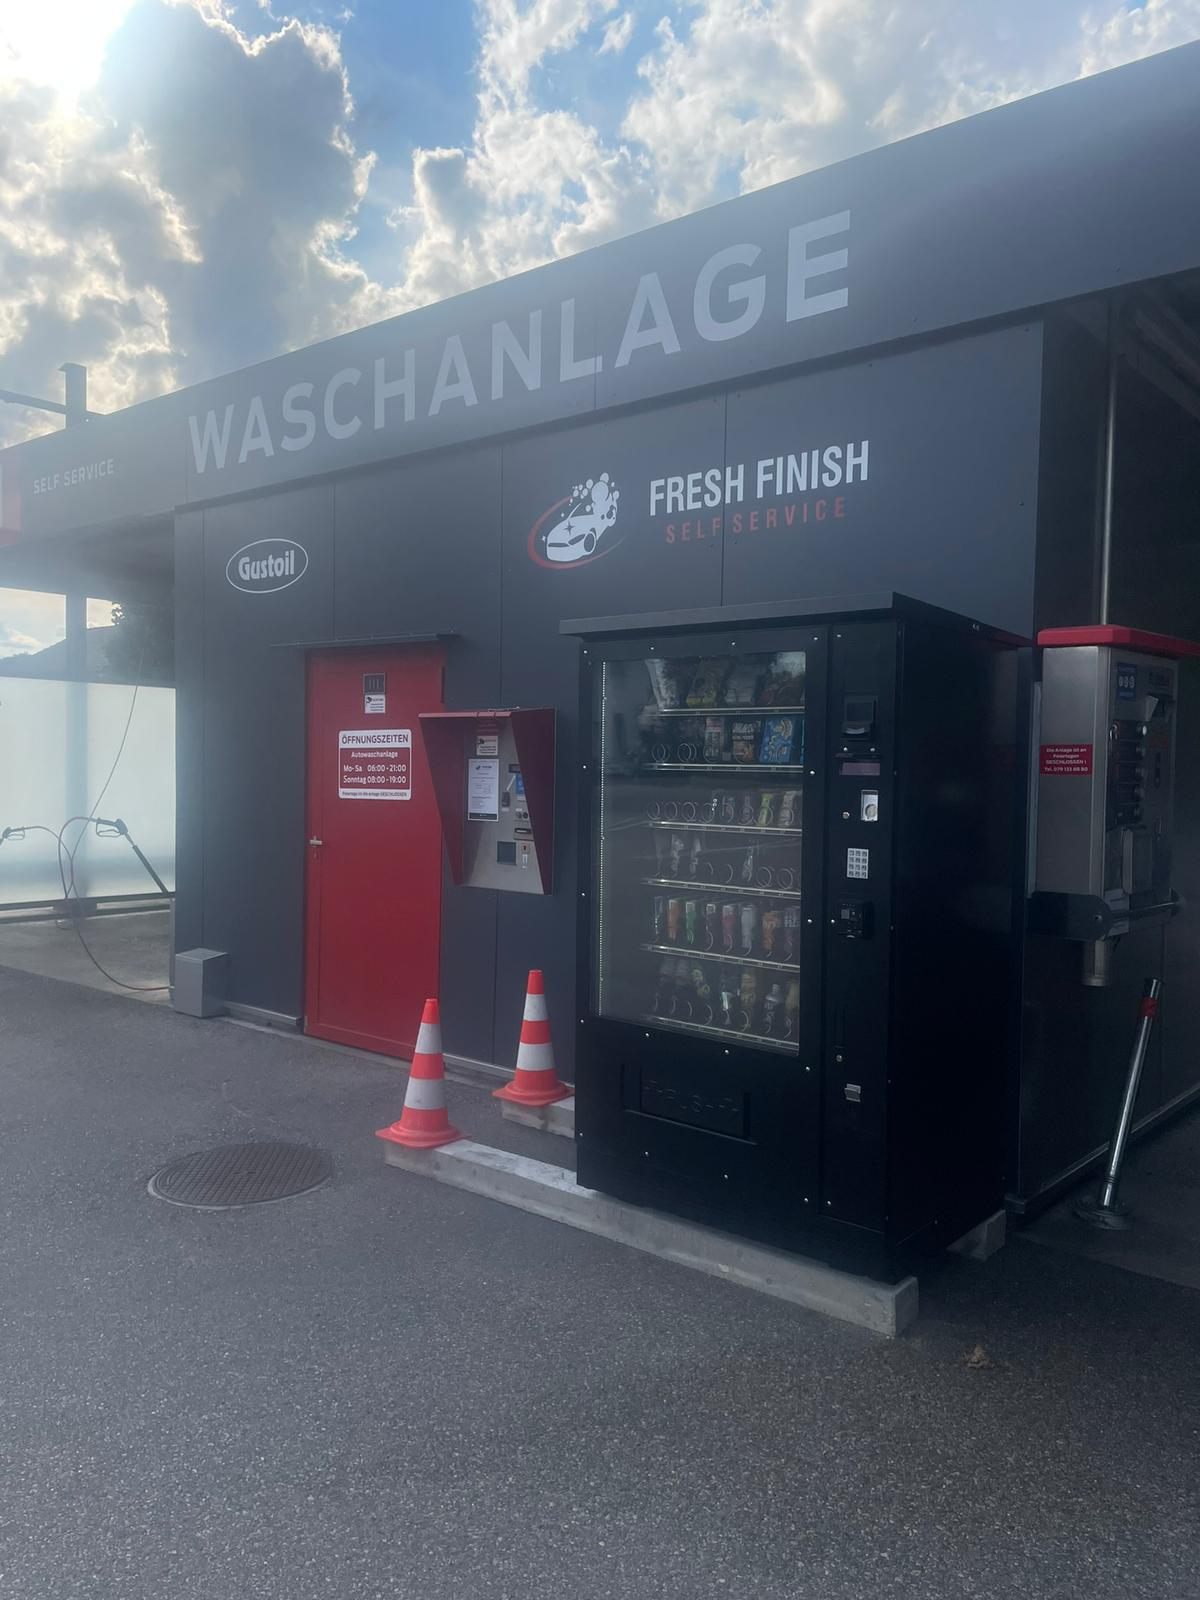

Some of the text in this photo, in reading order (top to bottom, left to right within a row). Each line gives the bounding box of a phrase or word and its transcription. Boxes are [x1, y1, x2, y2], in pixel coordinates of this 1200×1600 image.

[188, 209, 850, 474] WASCHANLAGE
[33, 458, 115, 495] SELF SERVICE
[650, 440, 869, 516] FRESH FINISH
[666, 497, 846, 544] SELF SERVICE
[238, 550, 295, 581] Gustoil
[342, 734, 408, 744] ÖFFNUNGSZEITEN
[344, 775, 366, 784] Sonntag
